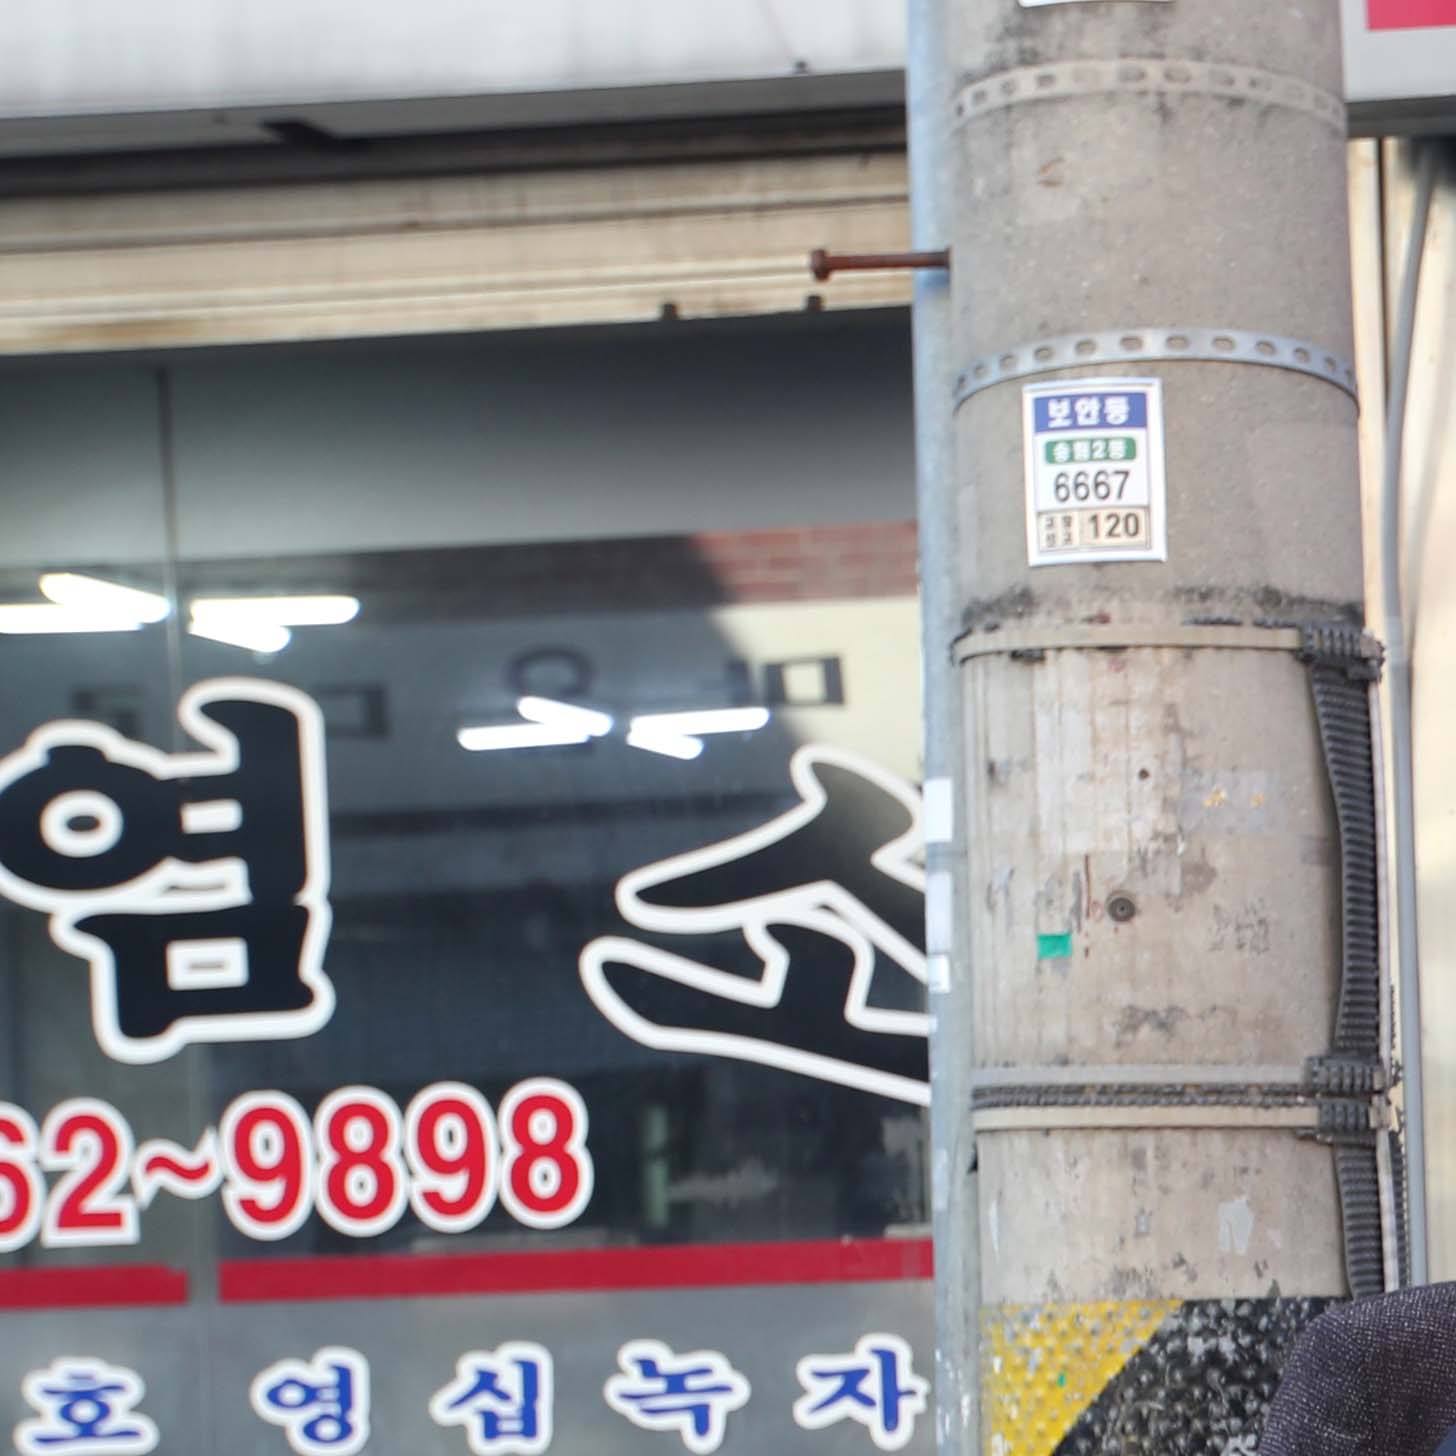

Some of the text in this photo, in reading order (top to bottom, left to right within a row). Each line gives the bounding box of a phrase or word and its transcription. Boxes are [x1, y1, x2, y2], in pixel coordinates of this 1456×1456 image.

[1047, 396, 1130, 428] 보안등
[1053, 470, 1130, 502] 6667
[1089, 512, 1140, 539] 120
